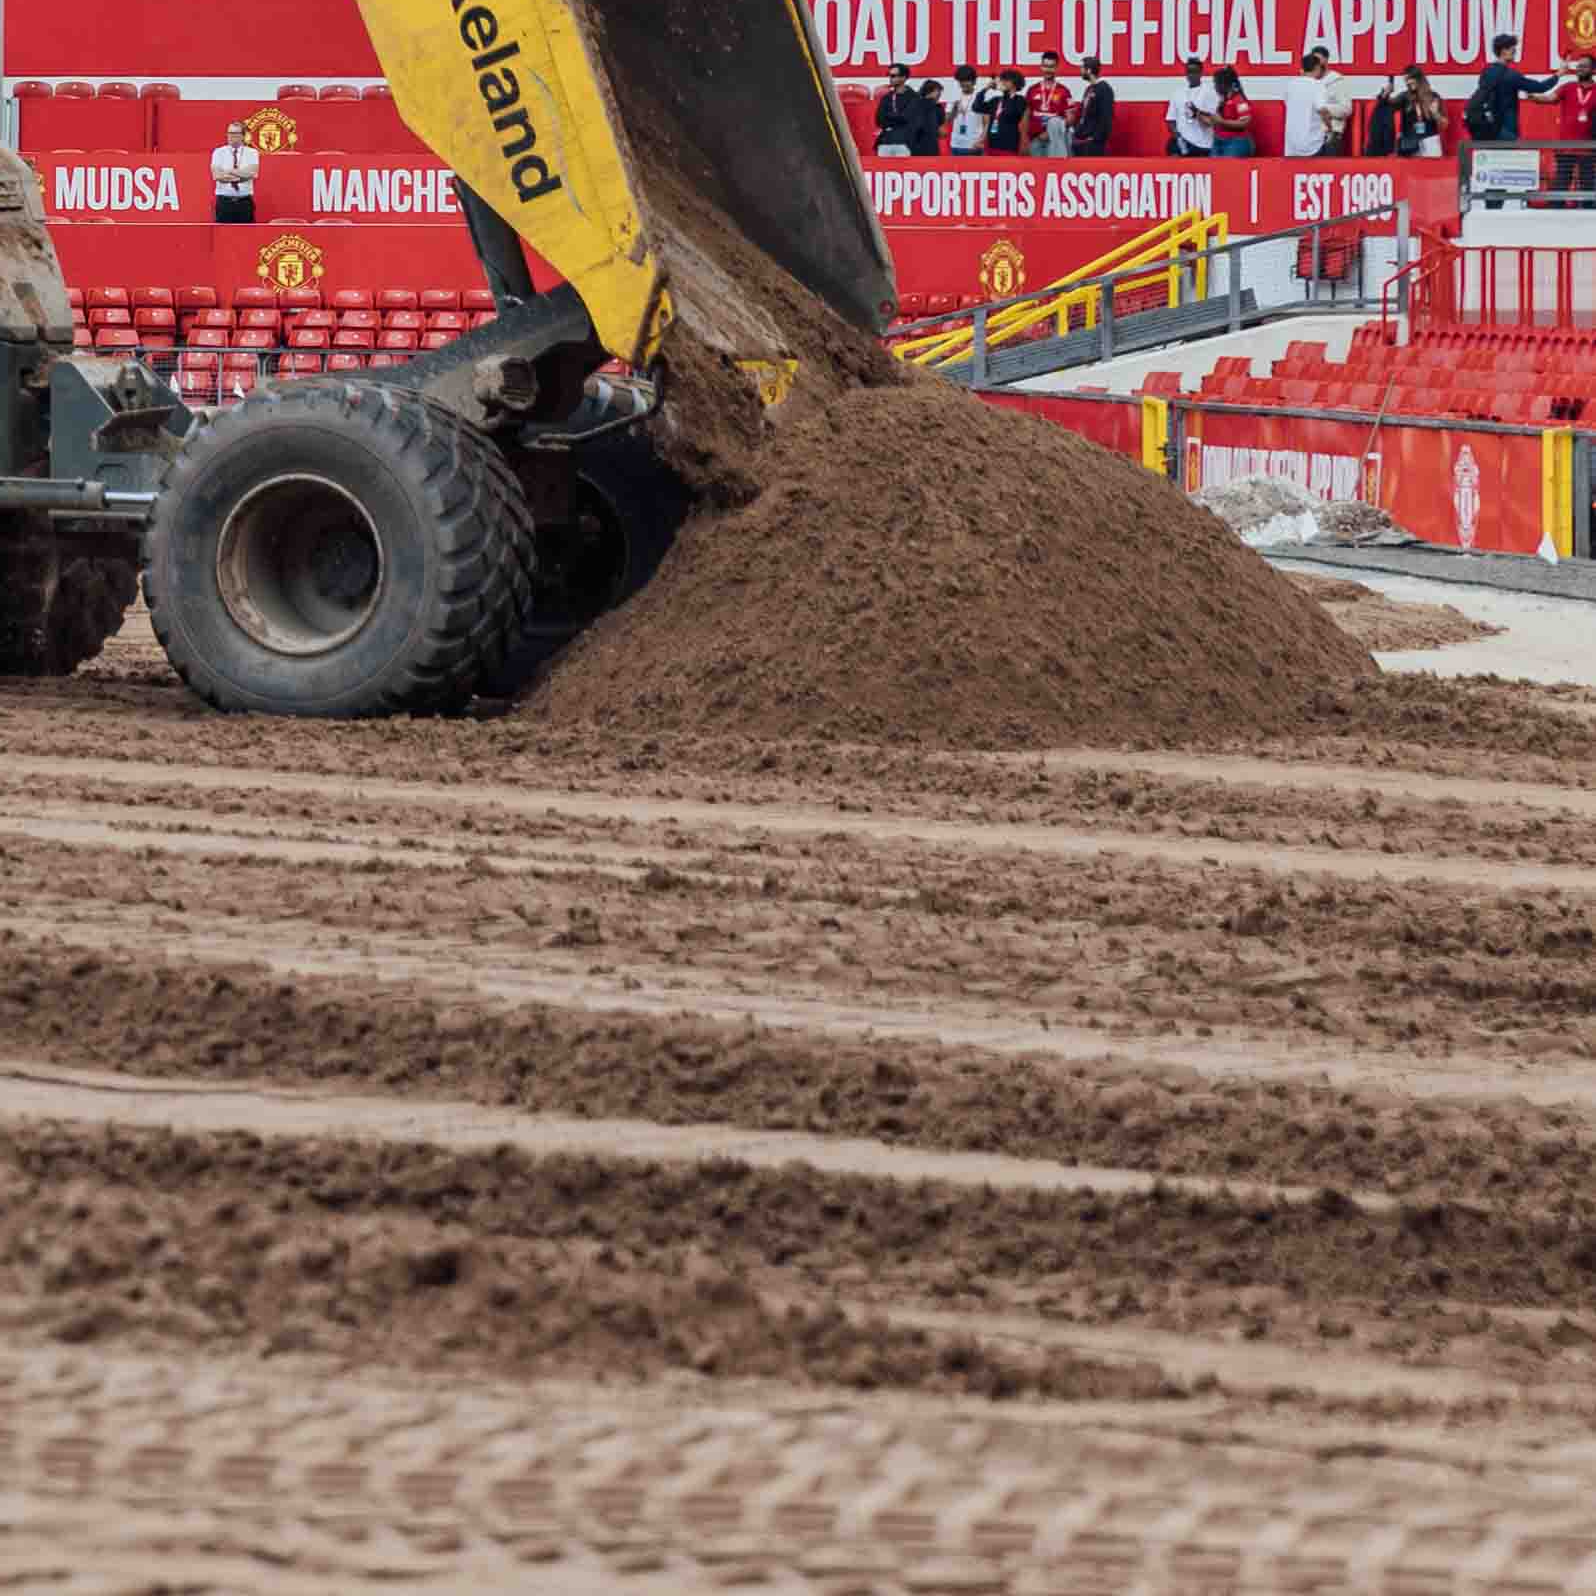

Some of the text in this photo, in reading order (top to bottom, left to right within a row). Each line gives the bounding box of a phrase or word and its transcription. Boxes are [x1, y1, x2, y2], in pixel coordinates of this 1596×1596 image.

[55, 167, 179, 211] MUDSA
[312, 169, 463, 212] MANCHE
[864, 171, 1393, 221] UPPORTERS ASSOCIATION EST 1989
